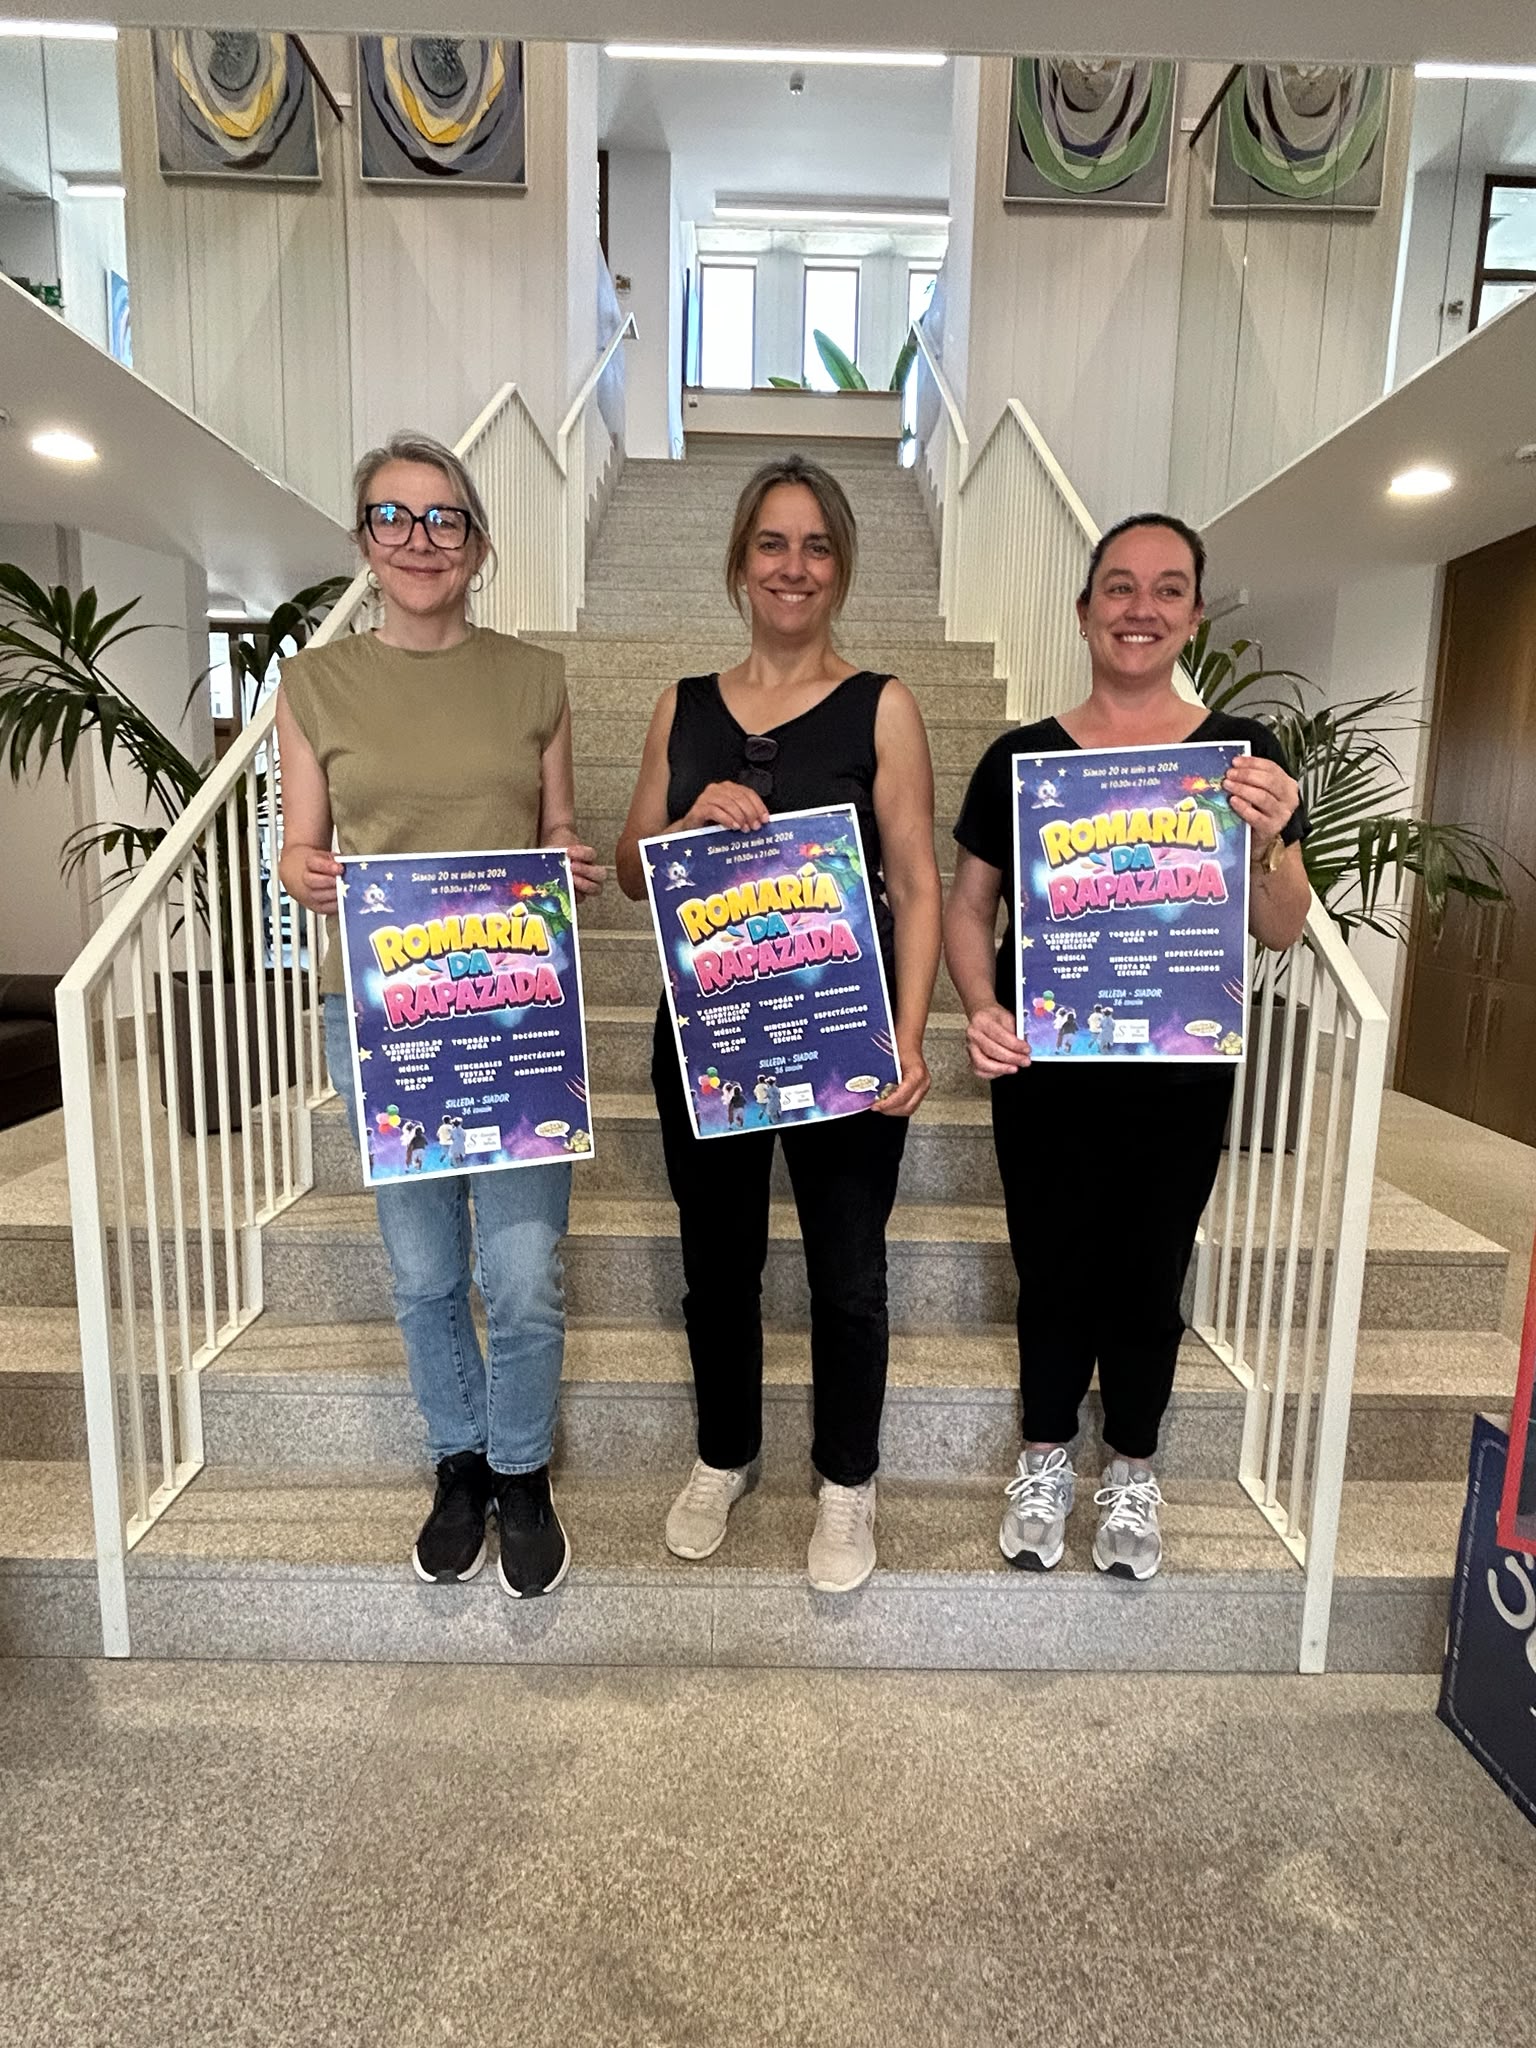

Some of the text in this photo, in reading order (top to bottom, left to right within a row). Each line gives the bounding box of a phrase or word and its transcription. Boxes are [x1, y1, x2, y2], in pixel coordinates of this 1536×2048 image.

[1108, 766, 1119, 776] 20
[1040, 797, 1217, 868] ROMARÍA
[730, 841, 741, 851] 20
[1111, 844, 1154, 873] DA
[438, 871, 449, 881] 20
[486, 868, 507, 879] 2026
[1049, 861, 1228, 921] RAPAZADA
[678, 863, 843, 945] ROMARÍA
[746, 912, 790, 944] DA
[371, 902, 551, 976] ROMARÍA
[693, 920, 861, 997] RAPAZADA
[1056, 953, 1086, 962] MÚSICA
[1164, 949, 1225, 958] ESPECTÁCULOS
[448, 950, 492, 980] DA
[384, 965, 564, 1030] RAPAZADA
[1098, 989, 1127, 999] SILLEDA
[1134, 988, 1162, 998] SIADOR
[813, 1004, 868, 1020] ESPECTÁCULOS
[713, 1026, 742, 1037] MÚSICA
[769, 1027, 804, 1038] FESTA DA
[712, 1037, 746, 1049] TIRO CON
[720, 1045, 740, 1054] ARCO
[509, 1049, 565, 1062] ESPECTÁCULOS
[759, 1056, 786, 1069] SILLEDA
[792, 1050, 818, 1063] SIADOR
[398, 1063, 430, 1073] MÚSICA
[460, 1068, 496, 1078] FESTA DA
[404, 1083, 426, 1091] ARCO
[445, 1097, 475, 1109] SILLEDA
[482, 1092, 510, 1104] SIADOR
